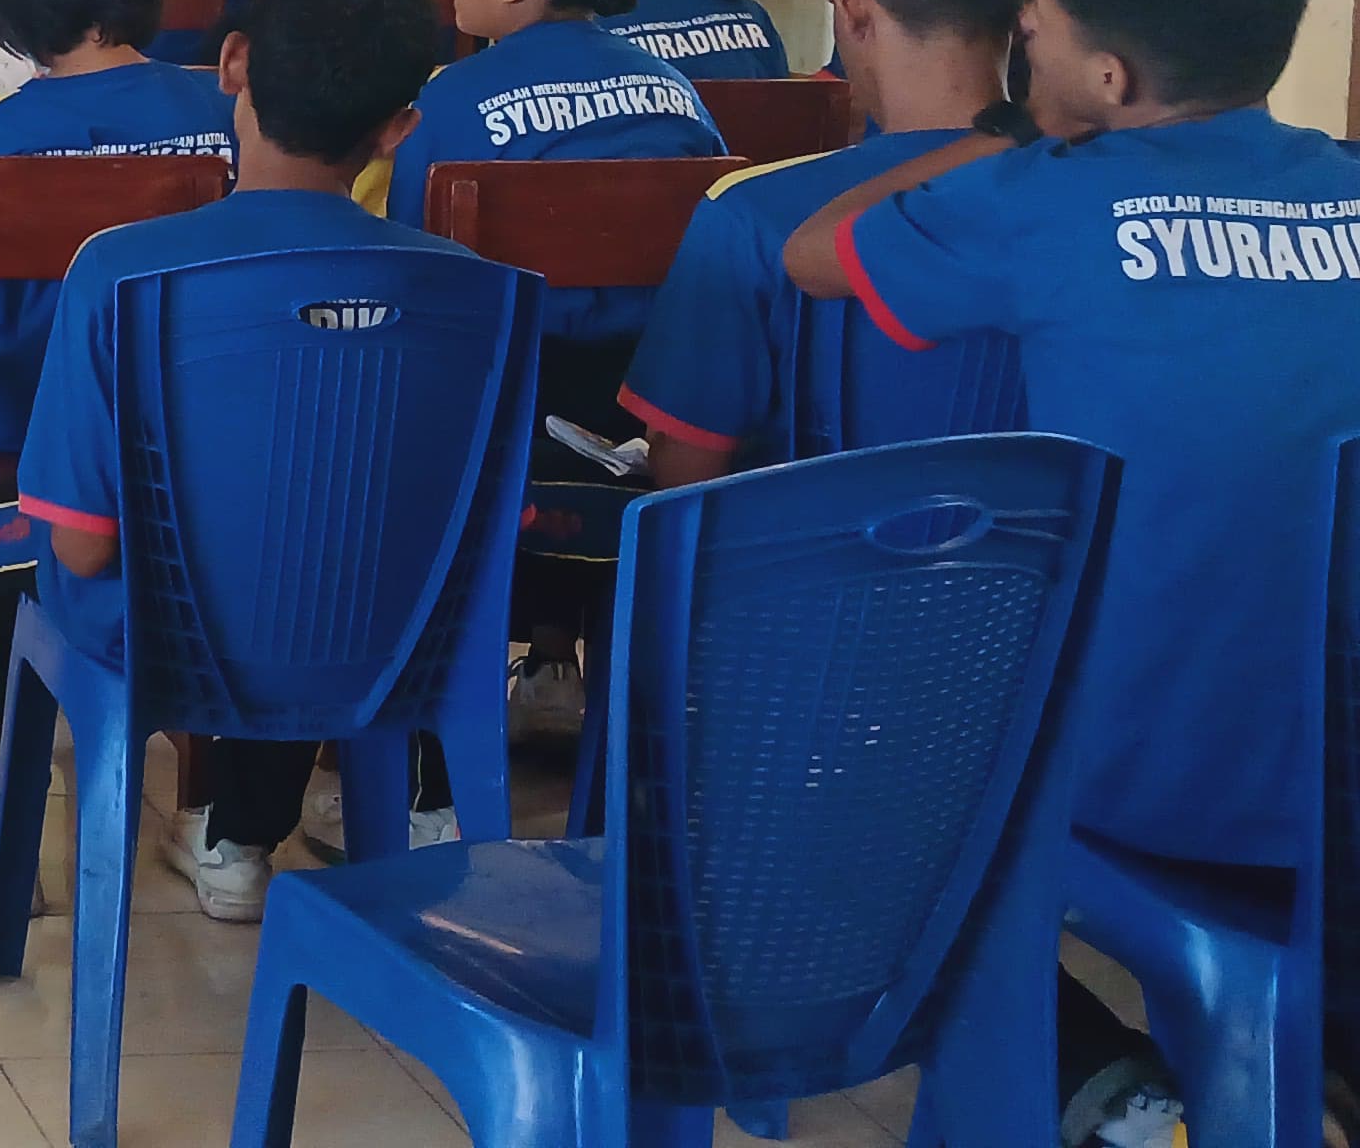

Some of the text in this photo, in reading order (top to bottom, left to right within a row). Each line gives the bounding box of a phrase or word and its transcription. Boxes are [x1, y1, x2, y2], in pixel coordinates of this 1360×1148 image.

[628, 23, 771, 60] URADIKAR
[478, 86, 531, 115] SEKOLAH
[532, 80, 600, 96] MENENGAH
[485, 85, 700, 146] SYURADIKARA
[1113, 195, 1201, 218] SEKOLAH
[1206, 196, 1308, 220] MENENGAH
